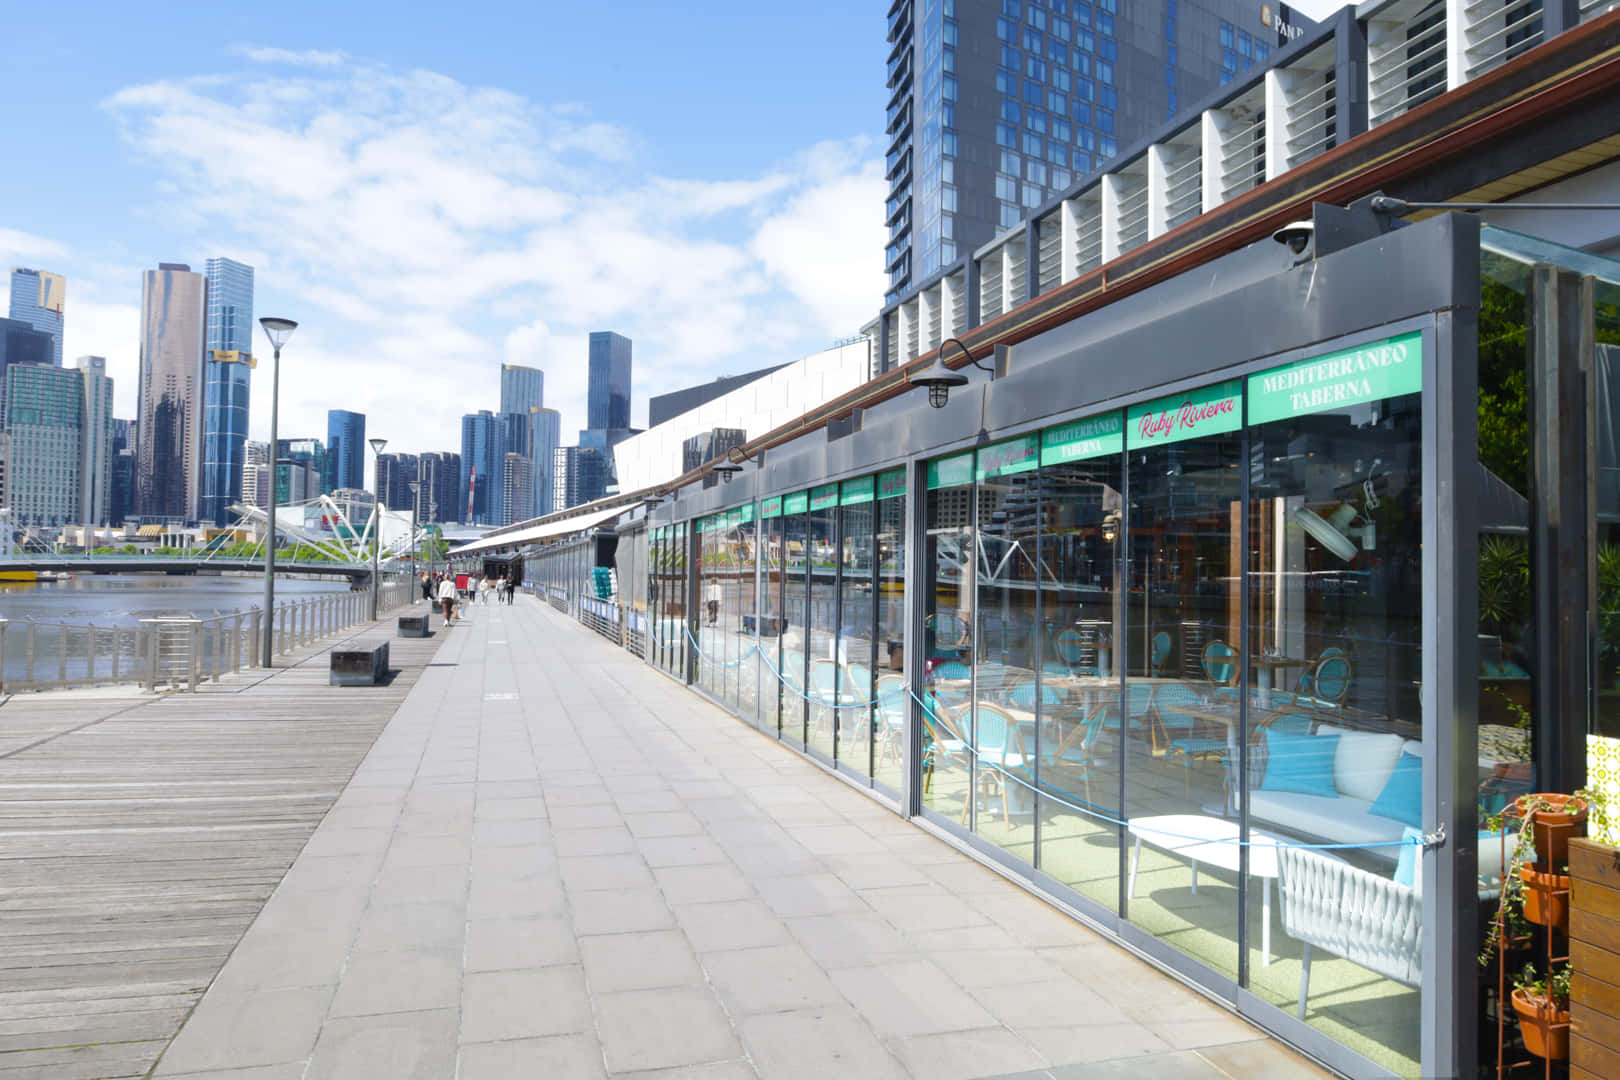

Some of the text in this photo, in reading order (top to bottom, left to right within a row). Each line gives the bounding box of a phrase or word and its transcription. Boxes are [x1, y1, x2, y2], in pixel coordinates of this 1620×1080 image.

[1274, 15, 1295, 40] PAN
[1263, 343, 1407, 393] MEDITERRÁNEO
[1290, 378, 1372, 411] TABERNA
[1138, 398, 1235, 440] Ruby Riviera
[1061, 439, 1103, 458] TABERNA
